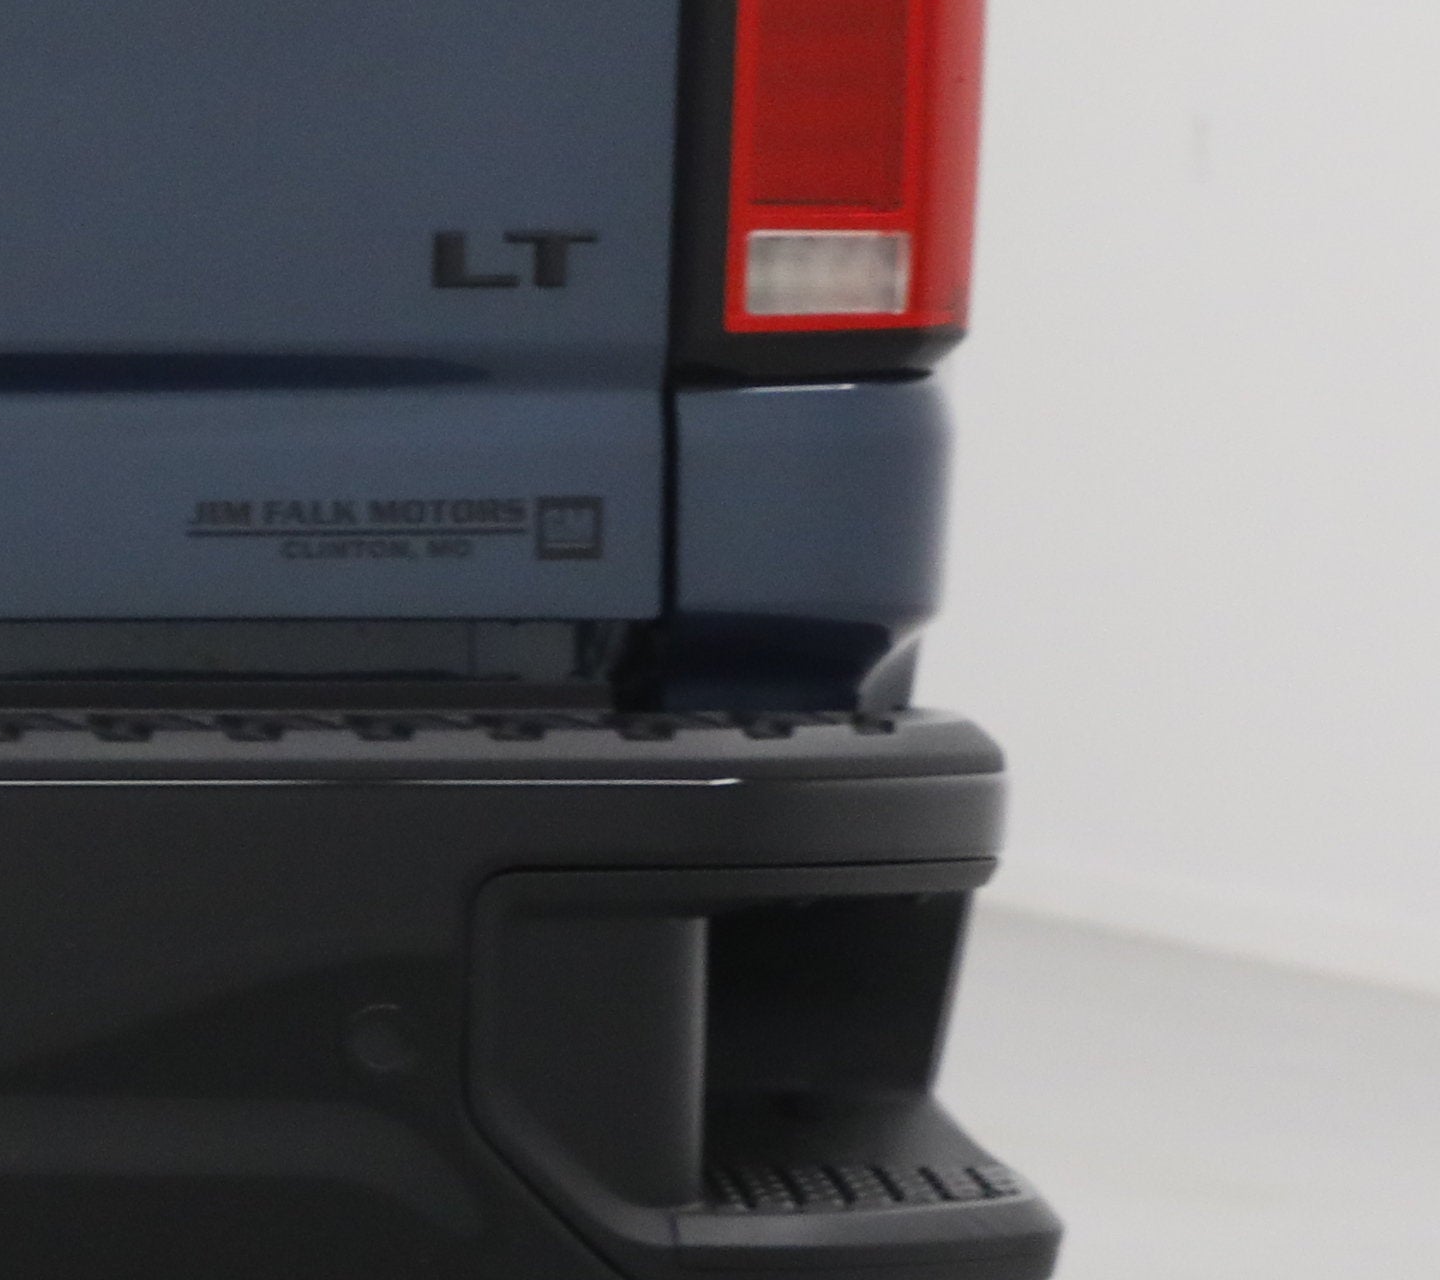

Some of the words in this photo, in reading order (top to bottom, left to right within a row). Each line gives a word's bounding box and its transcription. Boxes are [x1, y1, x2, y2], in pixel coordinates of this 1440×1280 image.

[433, 230, 598, 289] LT
[190, 500, 252, 526] JIM
[261, 500, 357, 526] FALK
[367, 498, 527, 525] MOTORS
